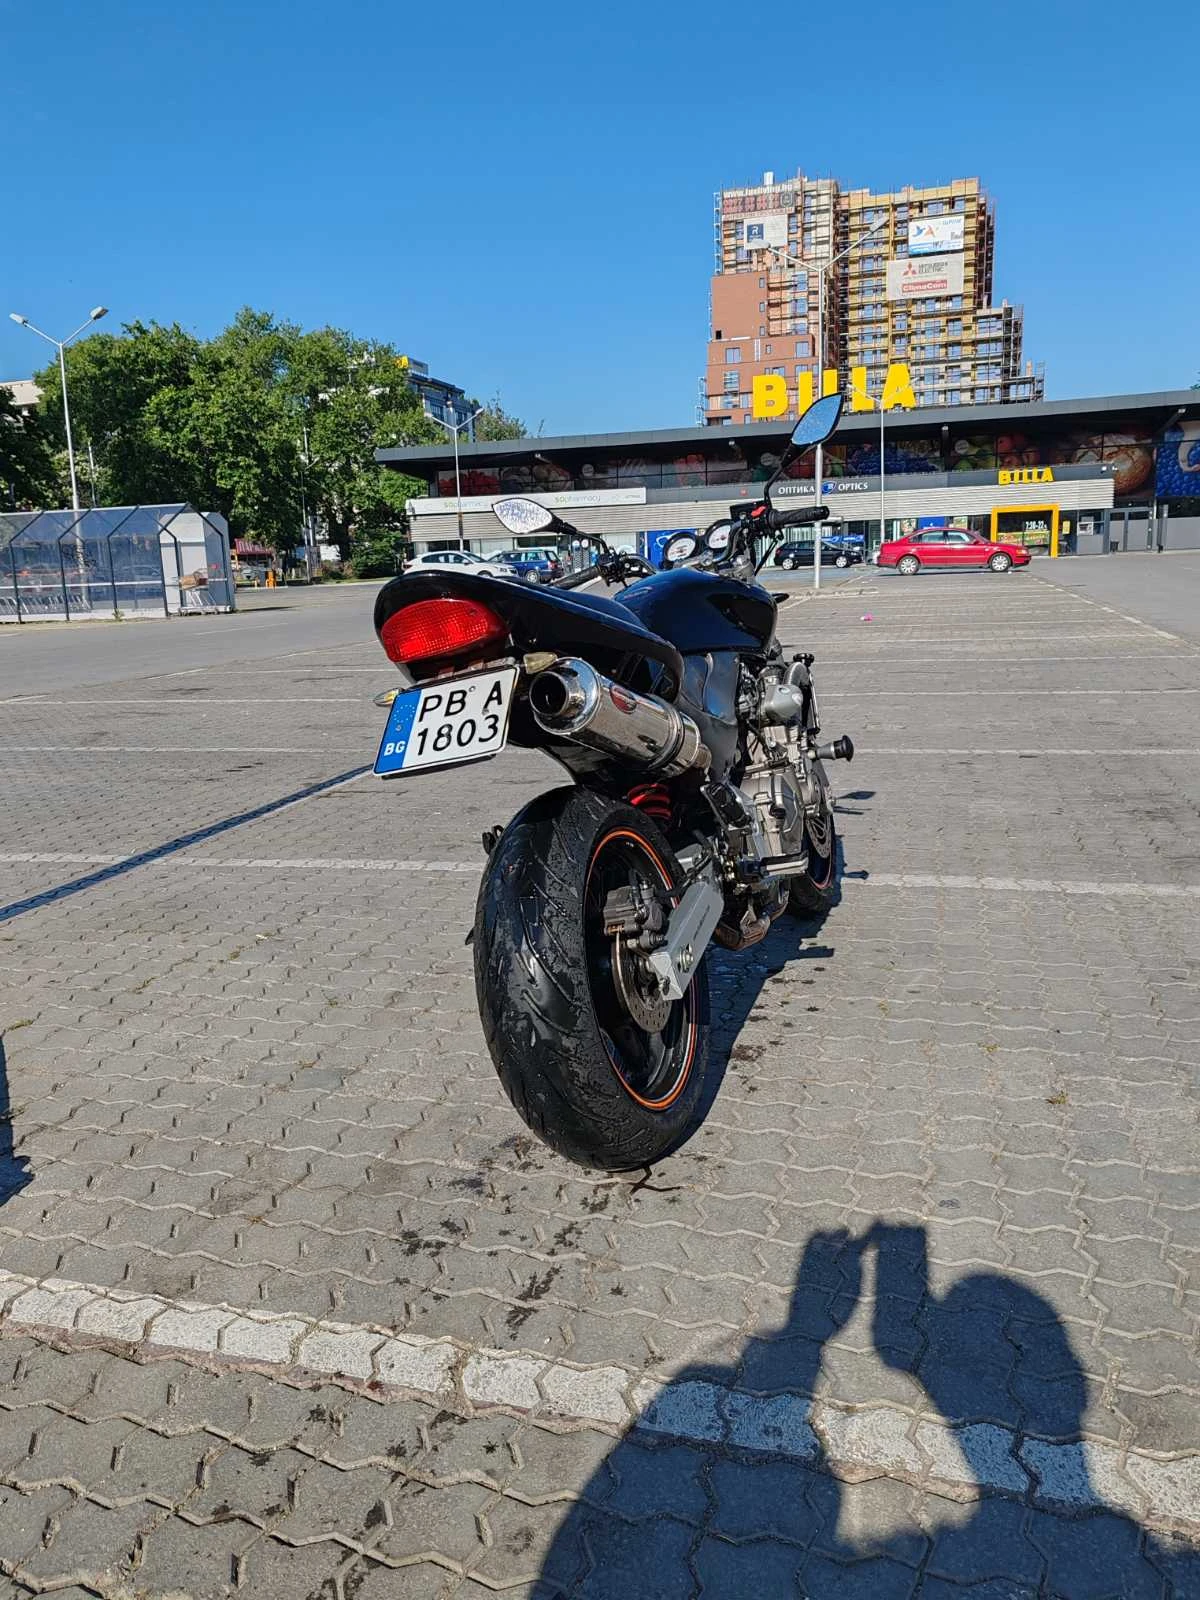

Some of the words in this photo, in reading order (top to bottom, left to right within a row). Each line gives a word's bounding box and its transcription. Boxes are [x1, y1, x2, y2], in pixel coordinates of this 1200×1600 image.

[998, 467, 1054, 485] BILLA
[778, 485, 815, 495] ОПТИКА
[838, 482, 868, 492] OPTICS
[418, 714, 499, 755] 1803
[384, 741, 406, 756] BG
